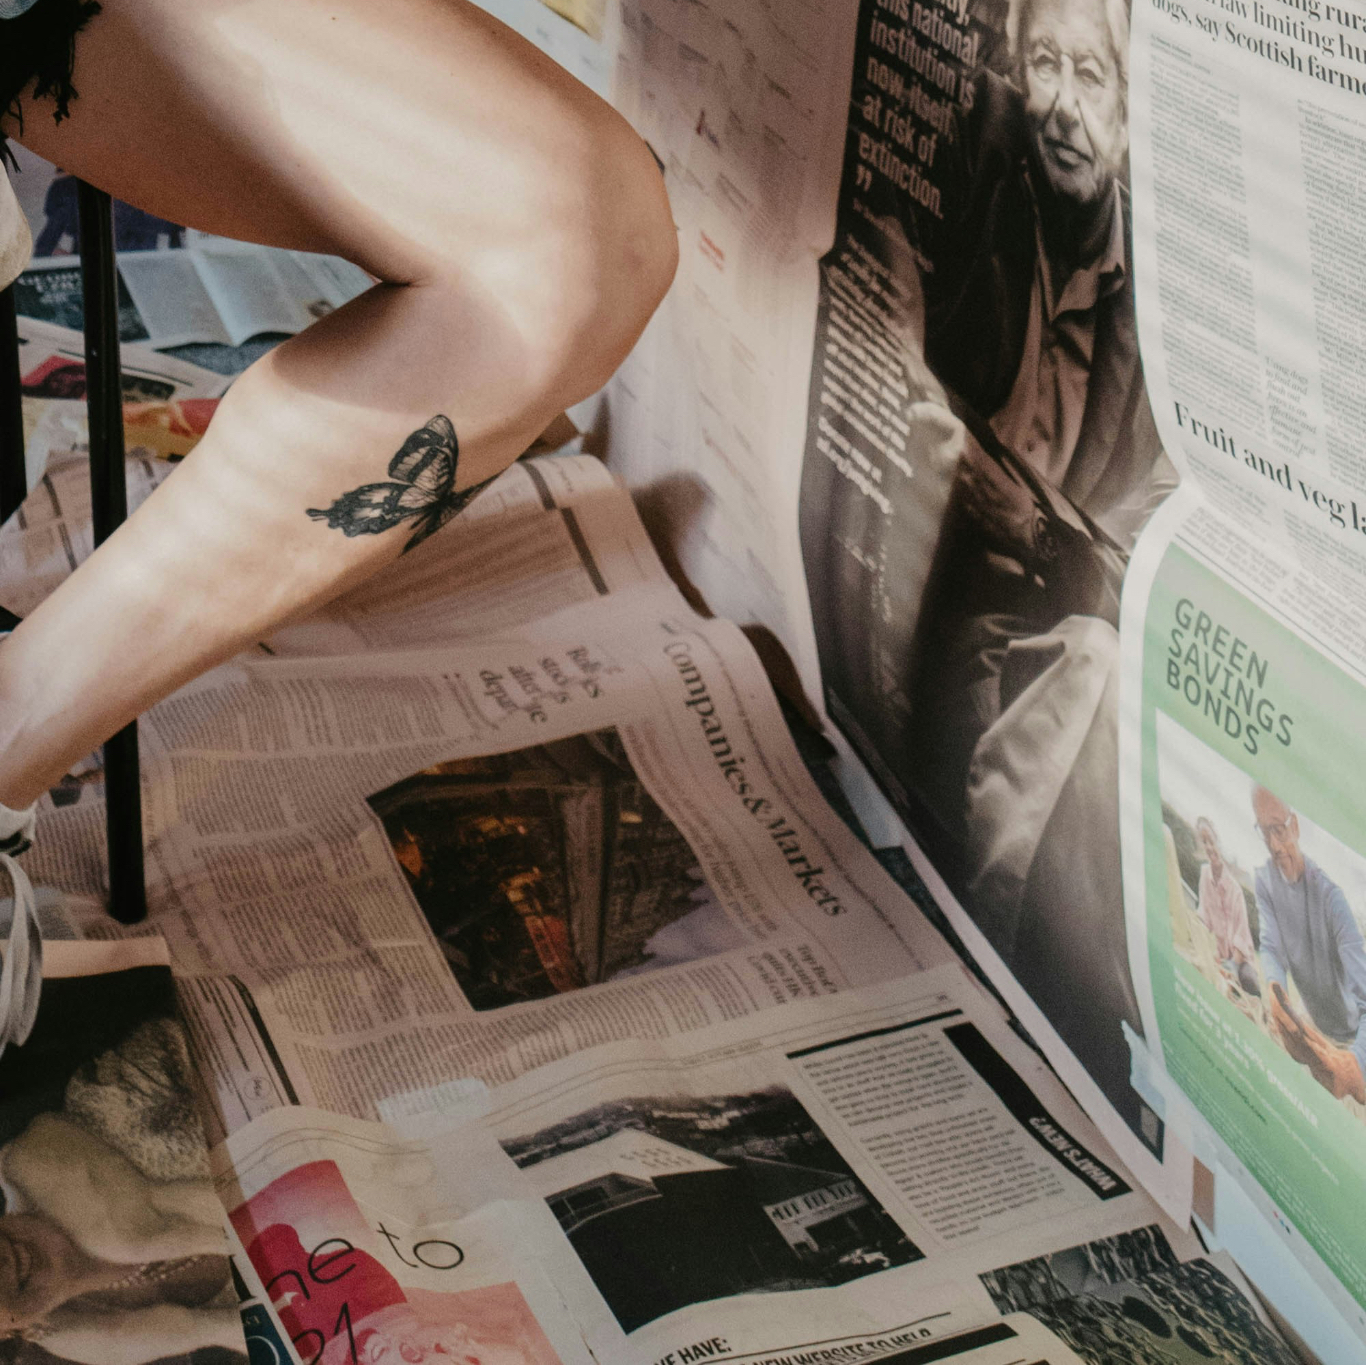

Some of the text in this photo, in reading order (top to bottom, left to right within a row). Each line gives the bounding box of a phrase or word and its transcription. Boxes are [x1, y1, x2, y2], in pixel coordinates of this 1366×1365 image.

[868, 9, 976, 112] institution is
[910, 1, 980, 70] national
[1194, 12, 1223, 43] say
[1224, 20, 1304, 74] Scottish
[1252, 0, 1336, 59] limiting
[861, 92, 938, 168] at risk of
[857, 131, 945, 221] extinction.
[1173, 400, 1238, 460] Fruit
[1243, 448, 1293, 493] and
[1297, 478, 1346, 529] veg
[1175, 597, 1269, 689] GREEN
[1166, 657, 1260, 756] BONDS
[1167, 628, 1294, 747] SAVINGS
[662, 639, 753, 794] Companies
[765, 809, 847, 917] Markets
[1028, 1116, 1119, 1193] WHAT'S NEW?
[377, 1221, 465, 1270] to
[676, 1335, 733, 1365] HAVE:
